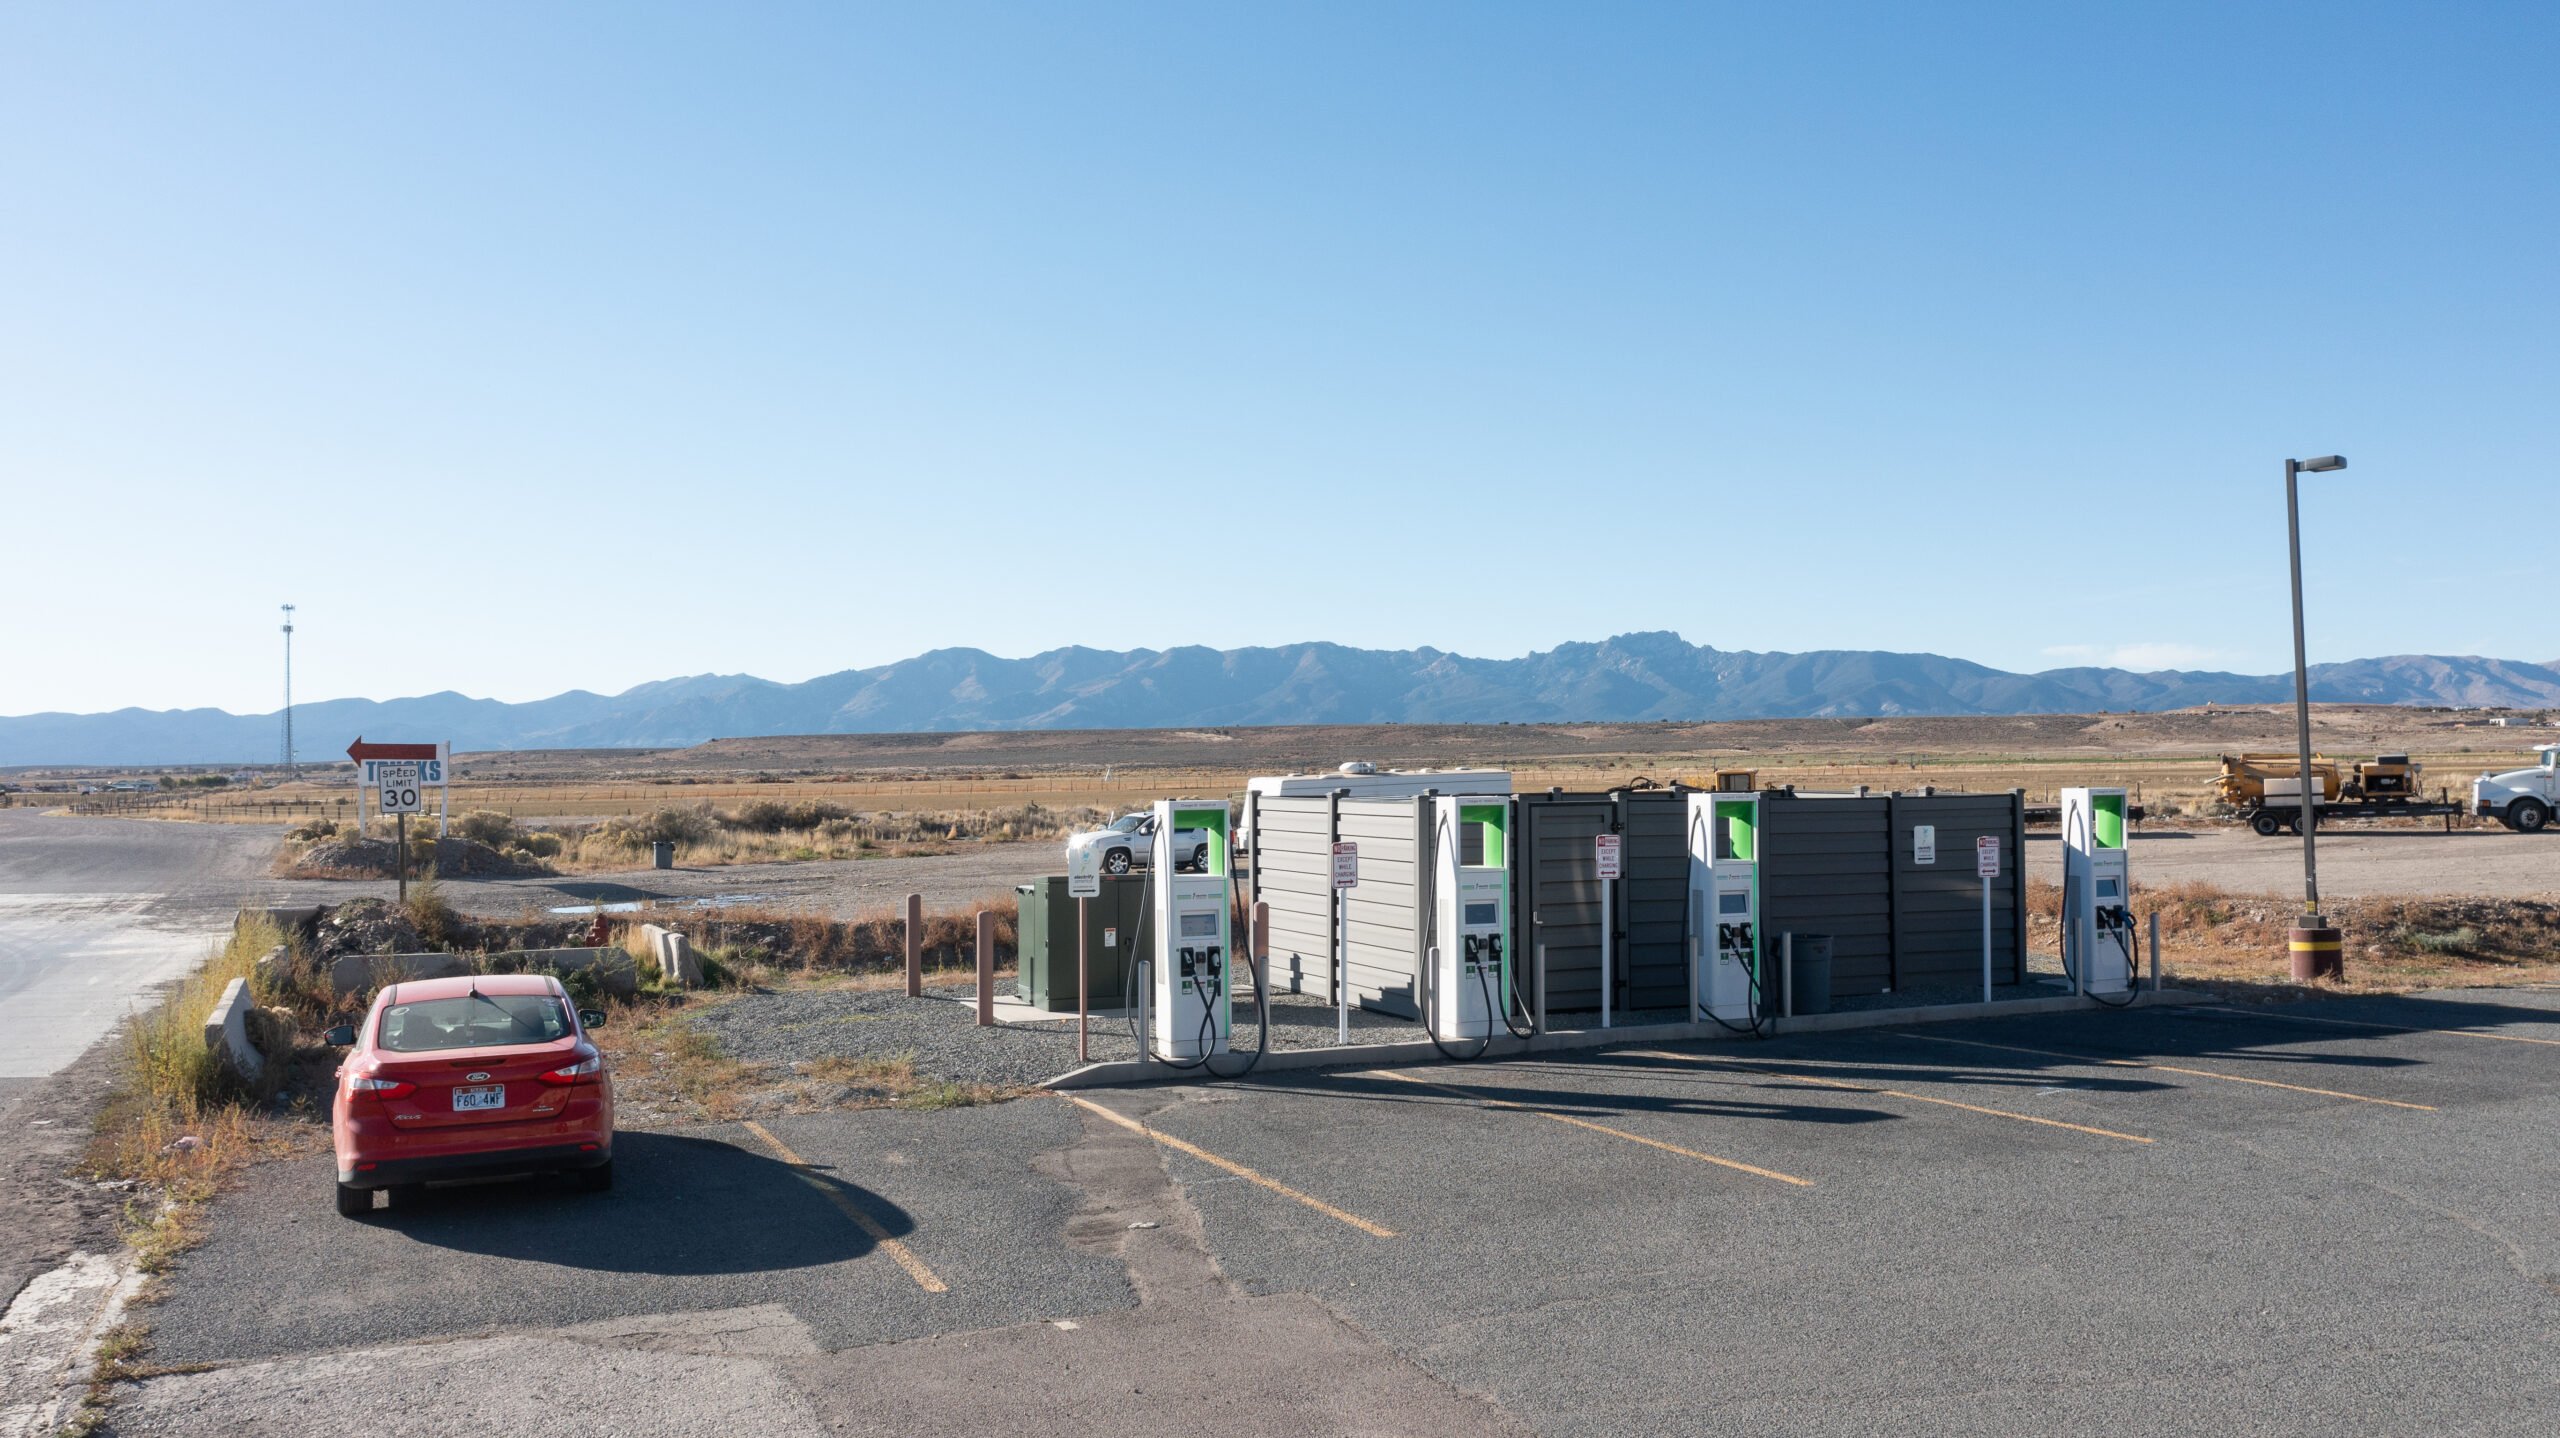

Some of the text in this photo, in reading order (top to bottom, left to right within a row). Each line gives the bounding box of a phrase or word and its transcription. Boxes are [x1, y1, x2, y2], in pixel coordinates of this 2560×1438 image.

[366, 761, 441, 781] TKS
[382, 769, 416, 778] SPEED
[386, 780, 412, 788] LIMIT
[384, 789, 416, 807] 30
